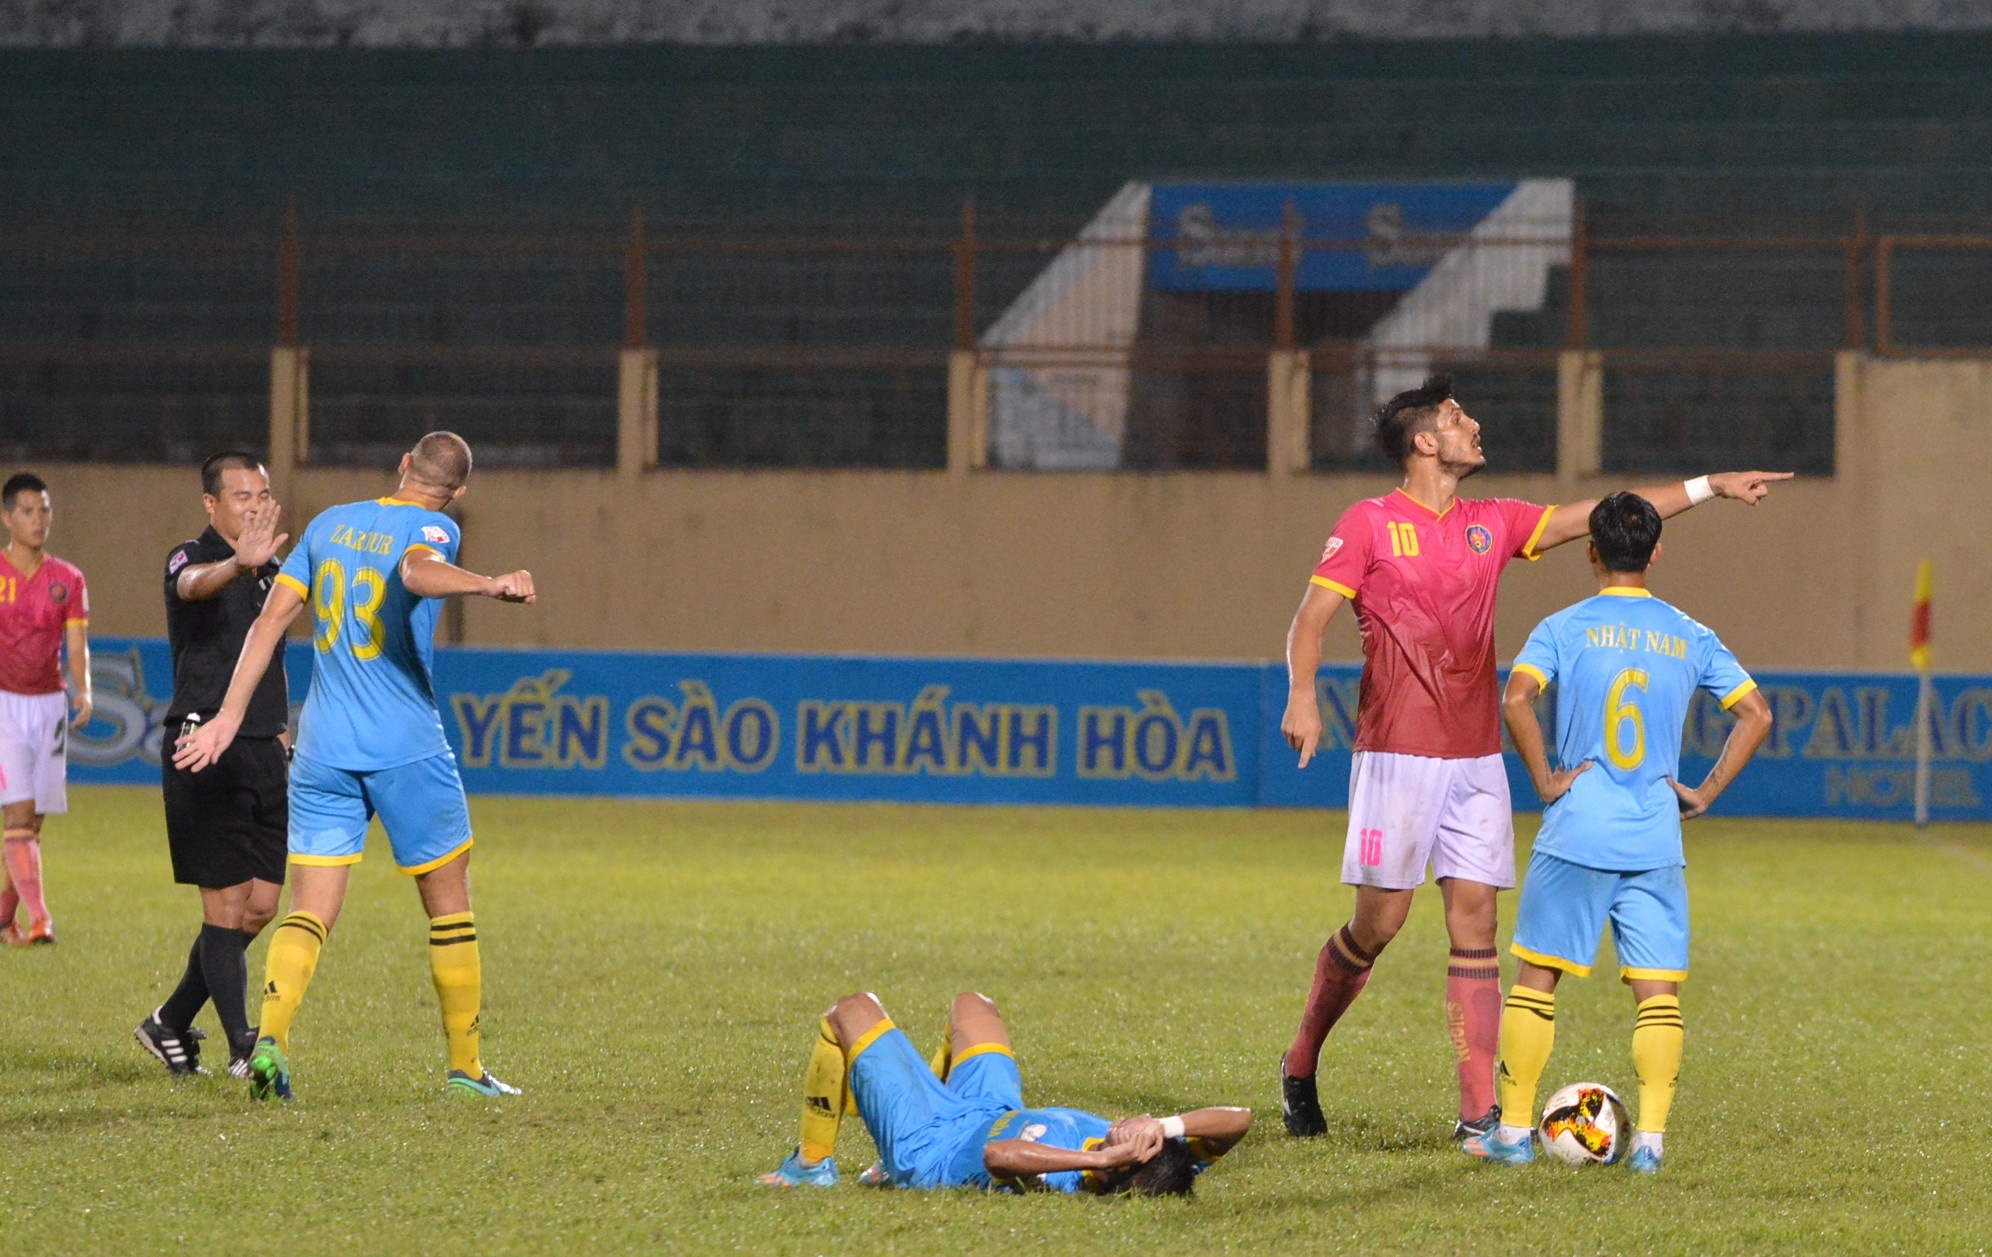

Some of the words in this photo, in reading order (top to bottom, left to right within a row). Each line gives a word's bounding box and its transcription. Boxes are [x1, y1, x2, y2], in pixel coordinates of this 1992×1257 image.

[1387, 521, 1420, 557] 10
[315, 557, 387, 662] 93
[1585, 621, 1641, 654] NHẬT
[1645, 630, 1688, 661] NAM
[452, 669, 608, 768] YẾN
[623, 680, 780, 772] SÀO
[796, 684, 1056, 777] KHÁNH
[1076, 689, 1236, 781] HÒA
[1603, 666, 1650, 772] 6
[1360, 827, 1384, 867] 10
